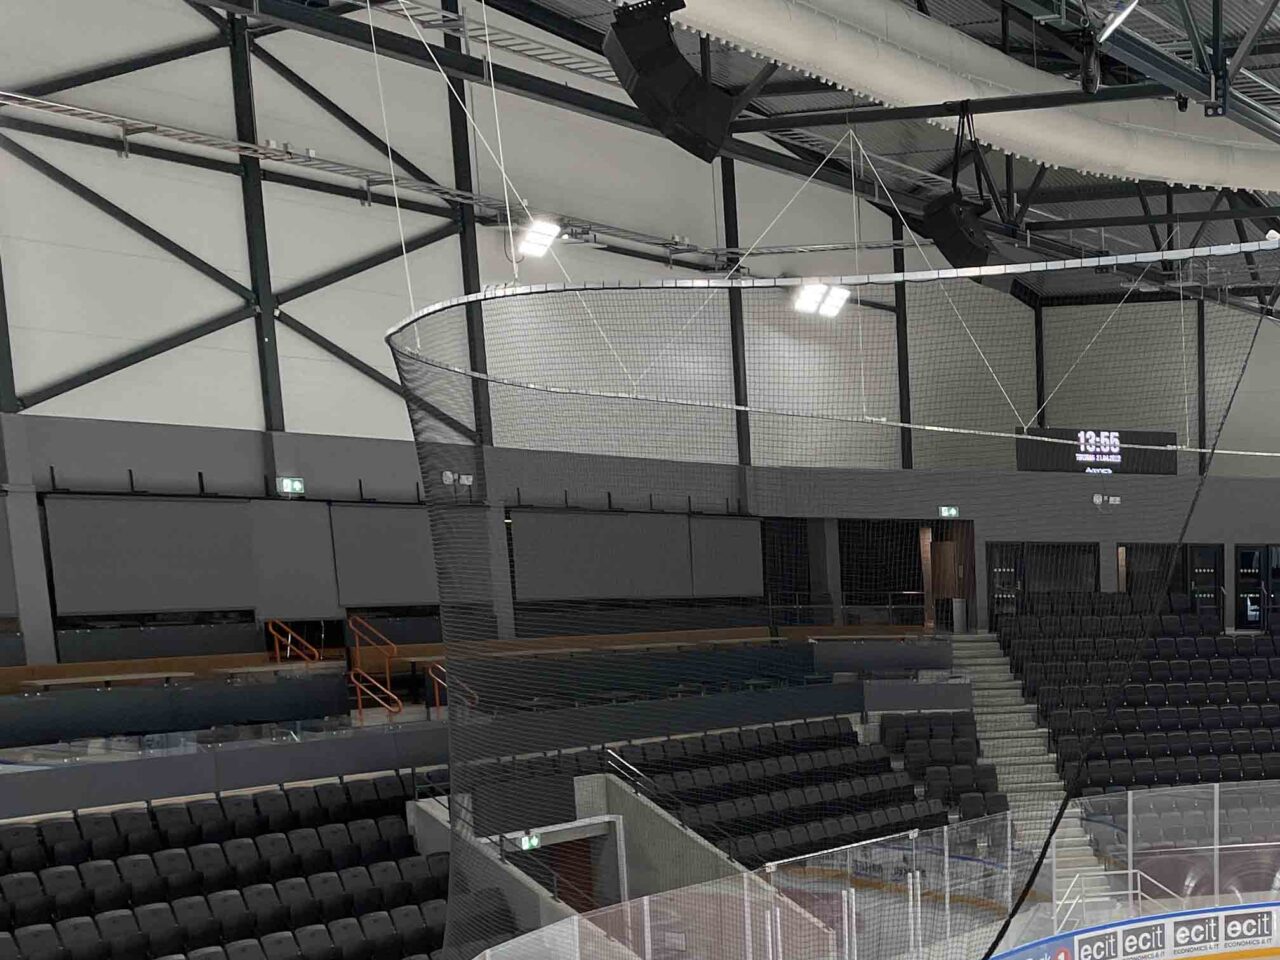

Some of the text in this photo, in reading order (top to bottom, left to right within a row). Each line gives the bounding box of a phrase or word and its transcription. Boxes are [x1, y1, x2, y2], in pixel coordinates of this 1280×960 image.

[1077, 431, 1120, 453] 13:55
[1175, 919, 1217, 945] ecit
[1226, 912, 1270, 938] ecit
[1124, 925, 1163, 953] ecit
